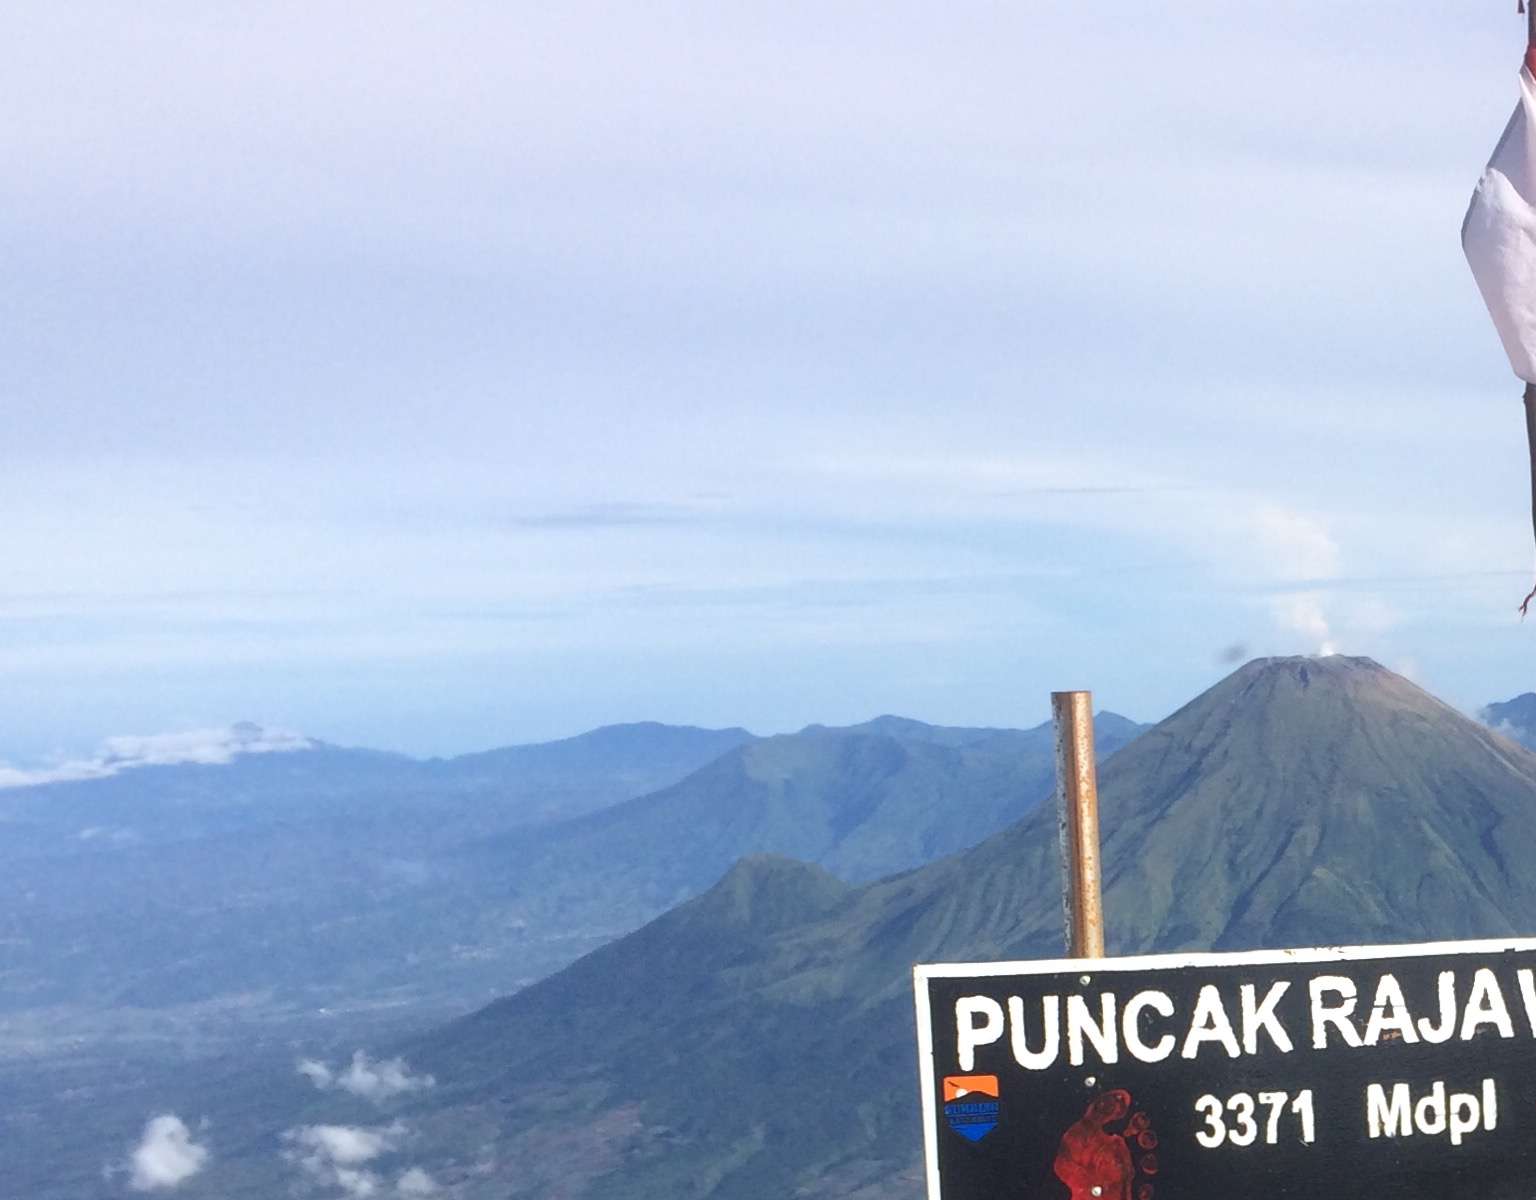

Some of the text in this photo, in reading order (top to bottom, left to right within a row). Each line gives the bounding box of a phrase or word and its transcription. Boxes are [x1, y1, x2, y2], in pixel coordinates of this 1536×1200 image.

[954, 980, 1294, 1072] PUNCAK
[1194, 1077, 1498, 1149] 3371 Mdpl
